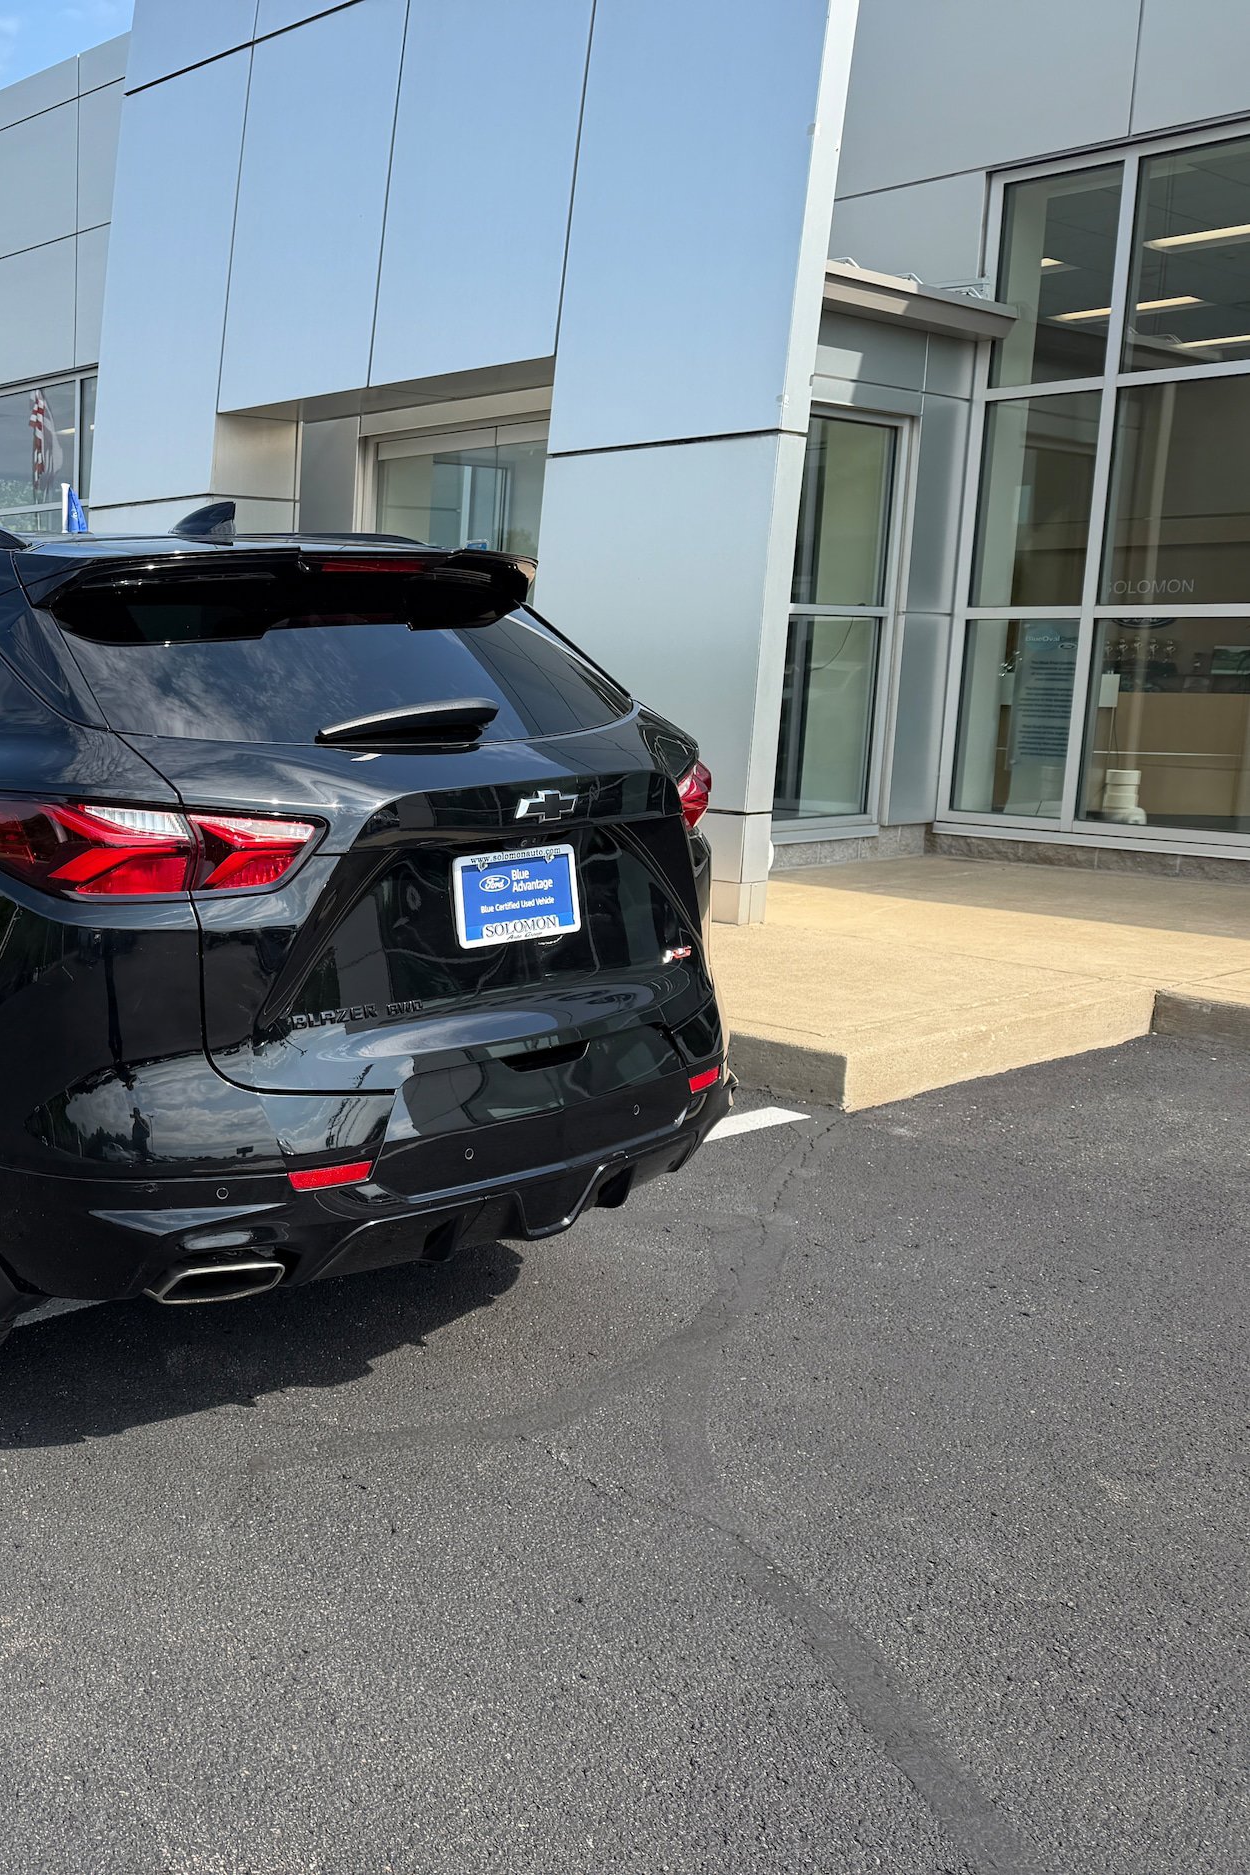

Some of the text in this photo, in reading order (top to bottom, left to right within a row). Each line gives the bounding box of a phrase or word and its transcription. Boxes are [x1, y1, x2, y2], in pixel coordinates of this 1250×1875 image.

[470, 847, 561, 864] www.solomonauto.com
[511, 868, 530, 880] Blue
[485, 877, 505, 889] Ford
[512, 878, 554, 893] Advantage
[480, 896, 555, 914] Blue Certified Used Vehicle
[485, 916, 557, 938] SOLOMON
[291, 1003, 378, 1030] BLAZER
